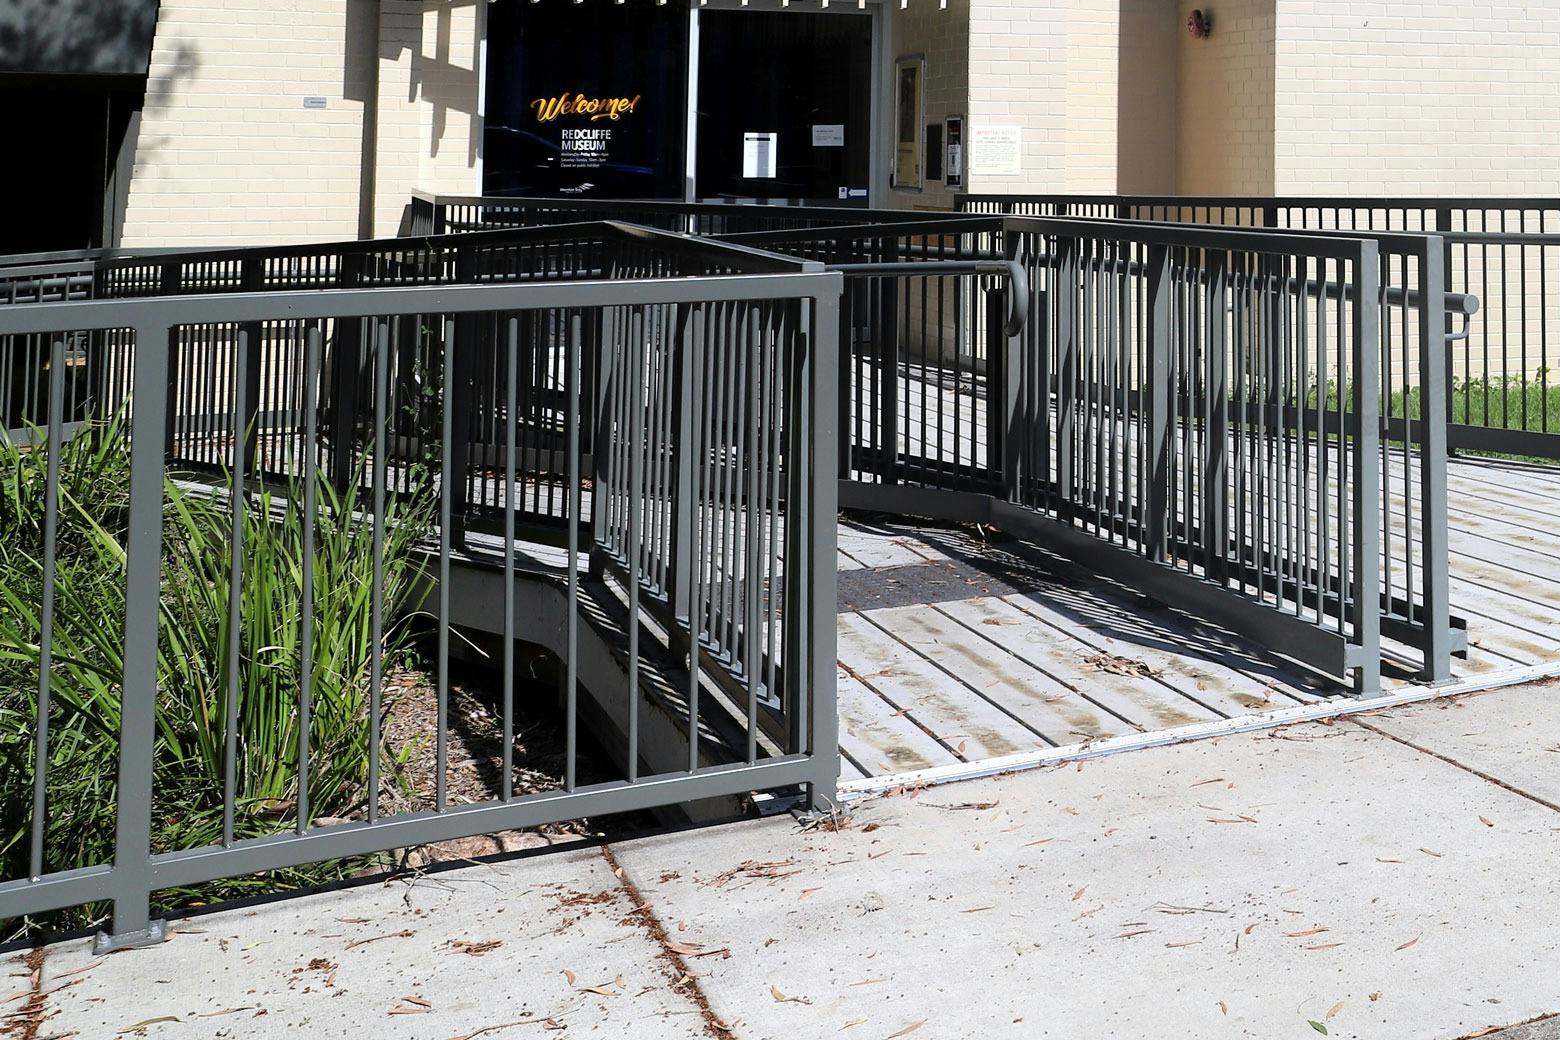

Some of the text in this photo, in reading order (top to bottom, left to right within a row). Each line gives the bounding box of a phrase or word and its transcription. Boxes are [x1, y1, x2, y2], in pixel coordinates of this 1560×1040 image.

[530, 92, 641, 123] Welcome!
[561, 129, 612, 140] REDCLIFFE
[561, 140, 606, 151] MUSEUM
